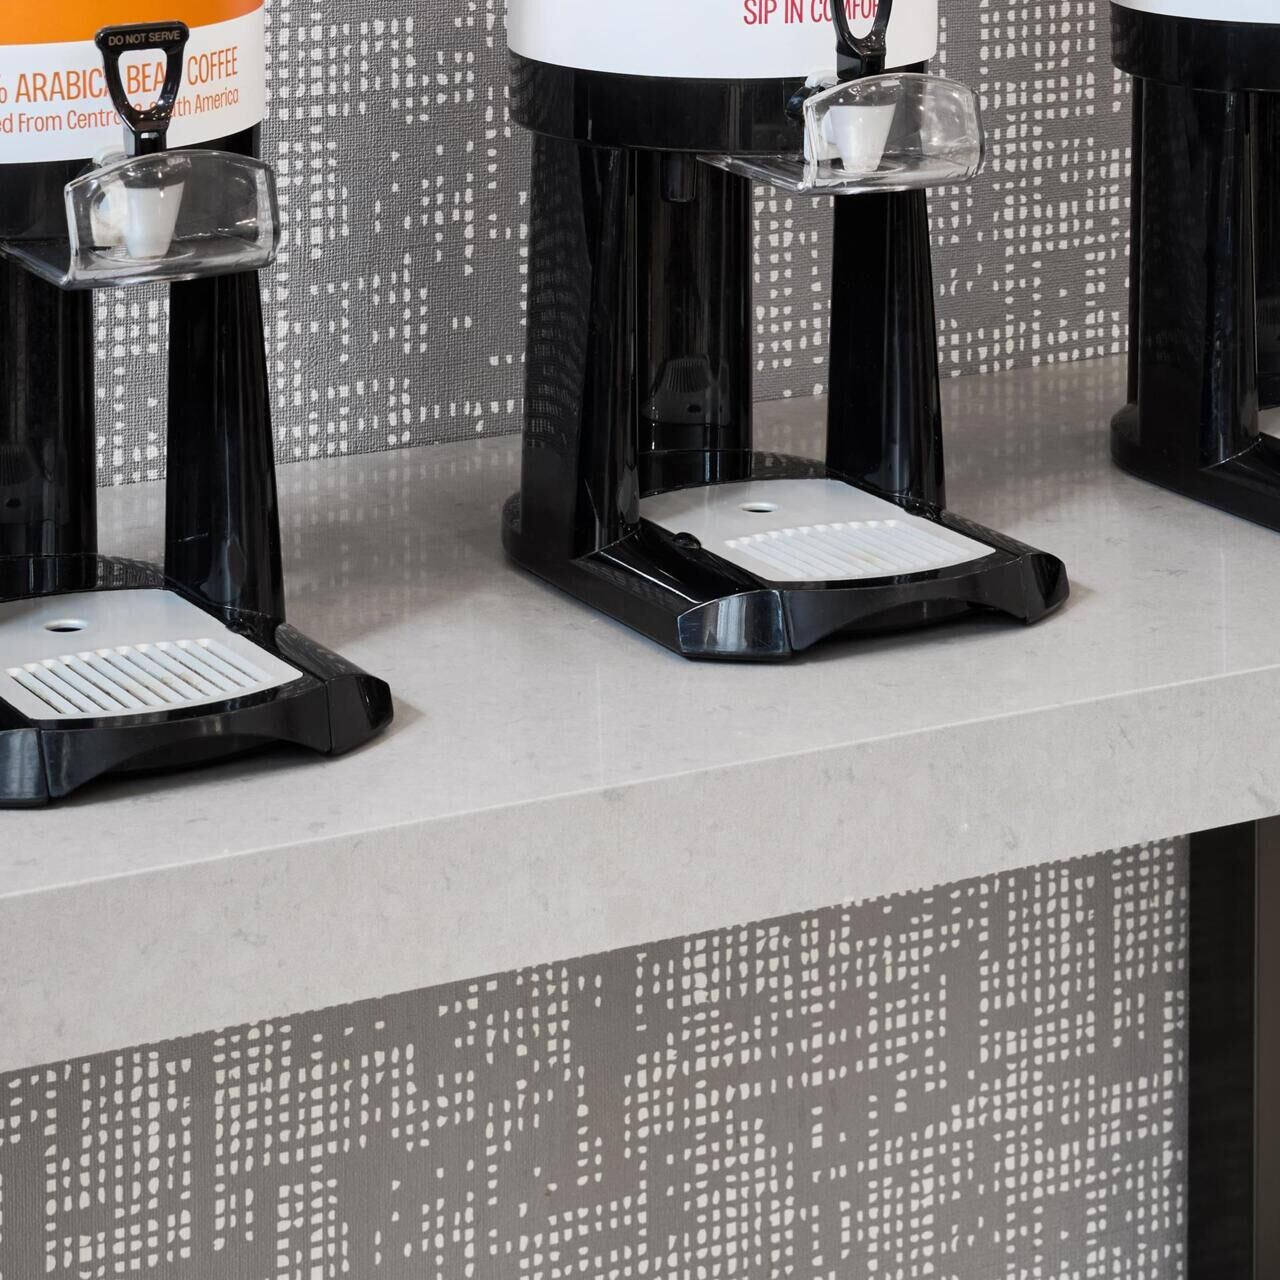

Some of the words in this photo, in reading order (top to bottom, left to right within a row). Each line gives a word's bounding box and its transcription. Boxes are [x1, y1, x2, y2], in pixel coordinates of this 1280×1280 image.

[108, 36, 124, 46] DO
[126, 33, 147, 44] NOT
[148, 30, 181, 41] SERVE
[187, 46, 239, 86] COFFEE
[18, 111, 63, 133] From
[194, 87, 240, 117] America
